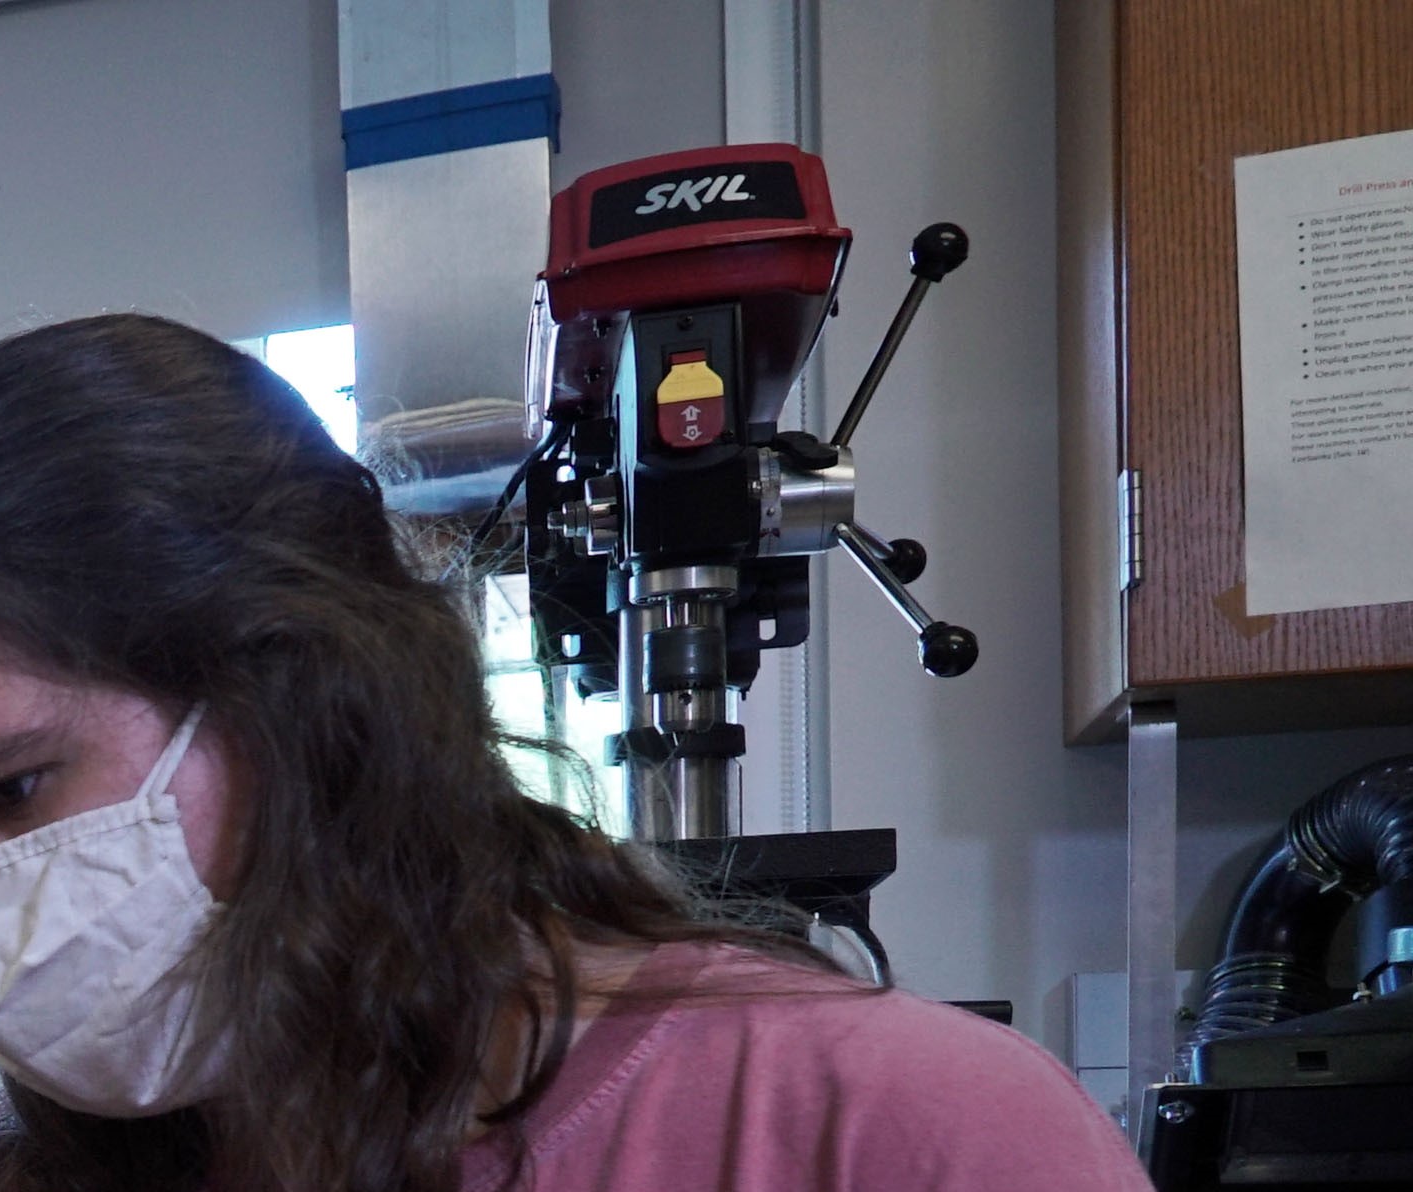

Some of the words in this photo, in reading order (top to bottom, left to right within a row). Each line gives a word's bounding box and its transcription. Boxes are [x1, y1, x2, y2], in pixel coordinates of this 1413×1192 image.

[635, 174, 750, 215] SKIL
[1339, 184, 1363, 196] Drill
[1366, 181, 1397, 191] Press
